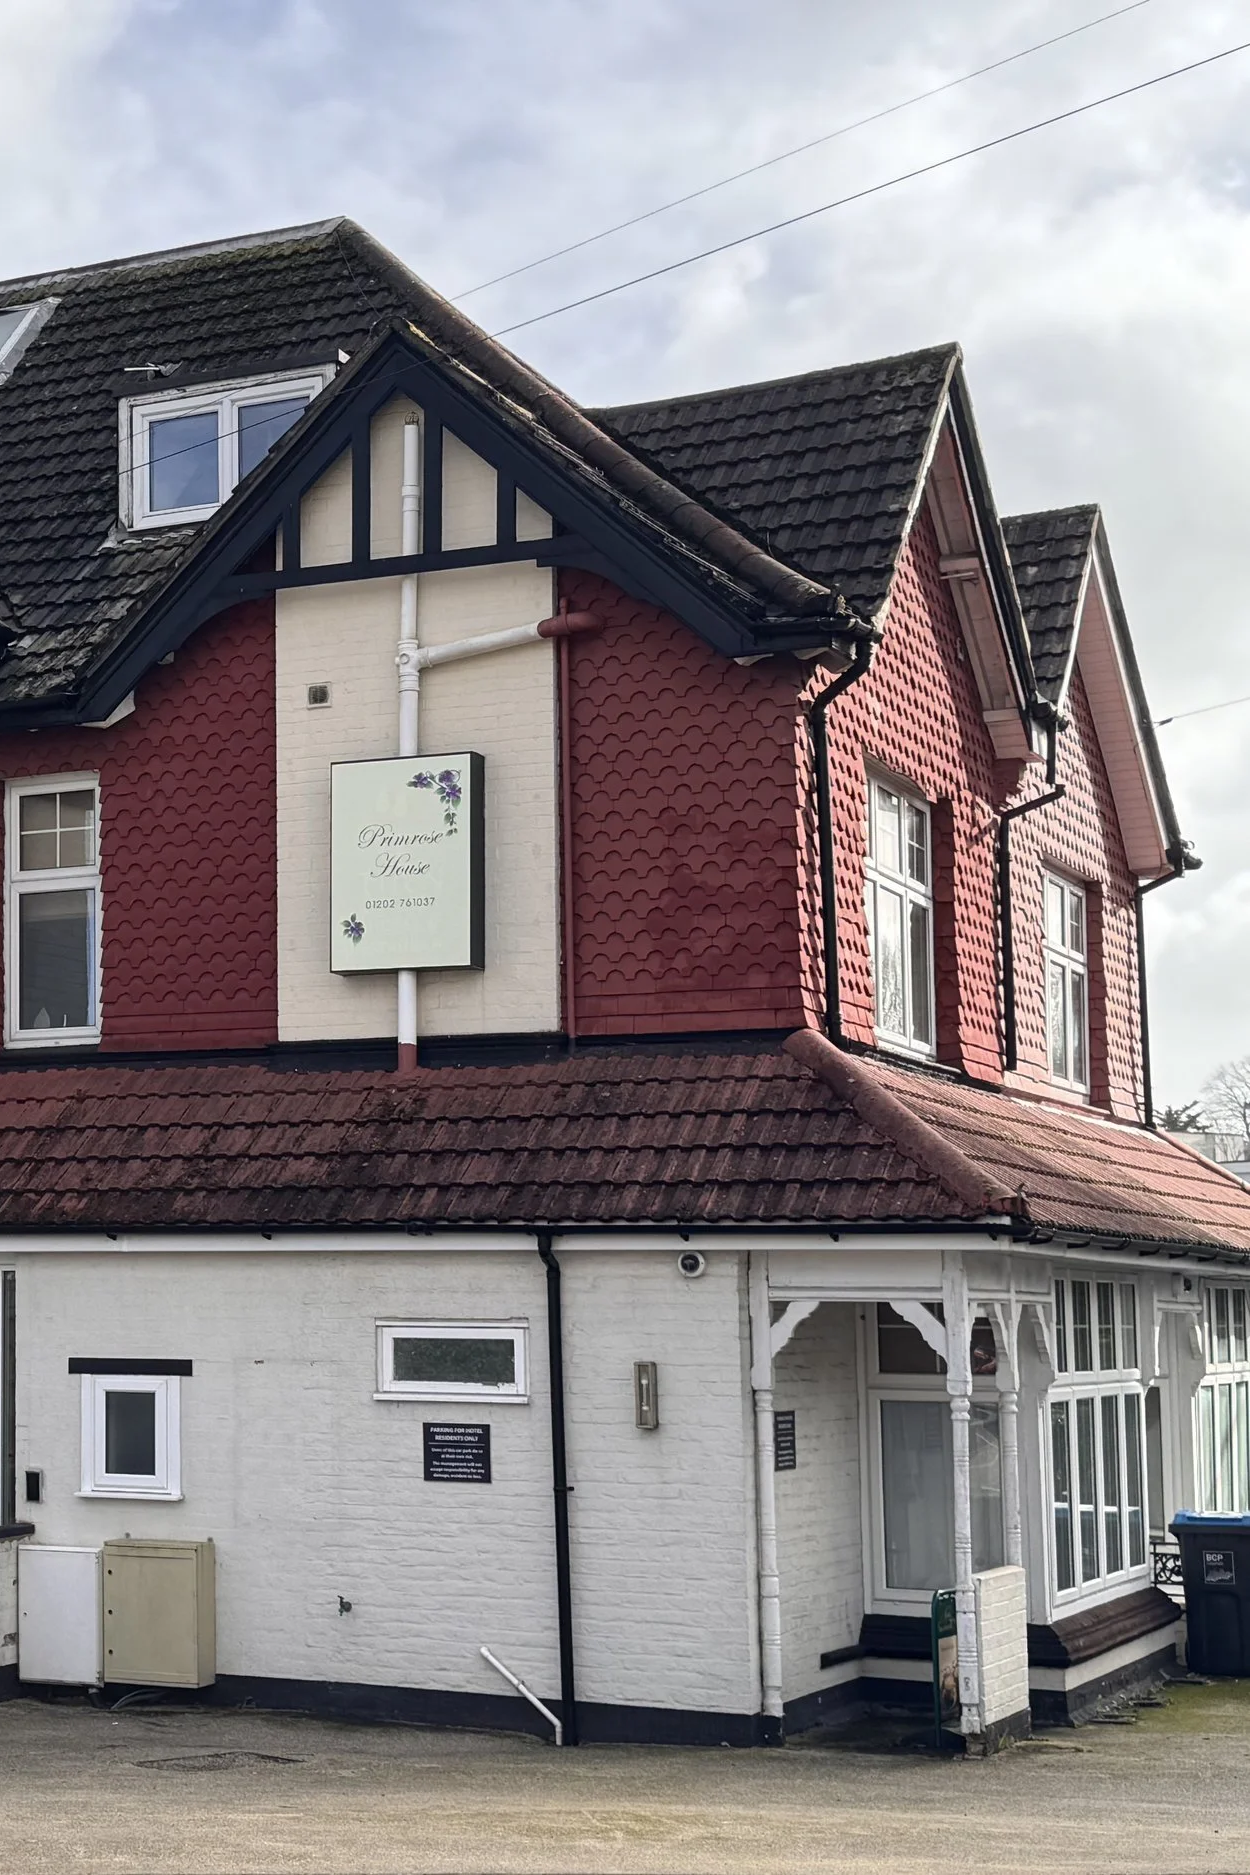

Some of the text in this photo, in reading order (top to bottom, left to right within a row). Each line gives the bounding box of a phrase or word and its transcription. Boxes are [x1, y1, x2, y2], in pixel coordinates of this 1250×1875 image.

[358, 823, 444, 849] Primrose
[370, 852, 430, 878] House
[365, 897, 435, 910] 01202 761037
[1205, 1553, 1224, 1562] BCP
